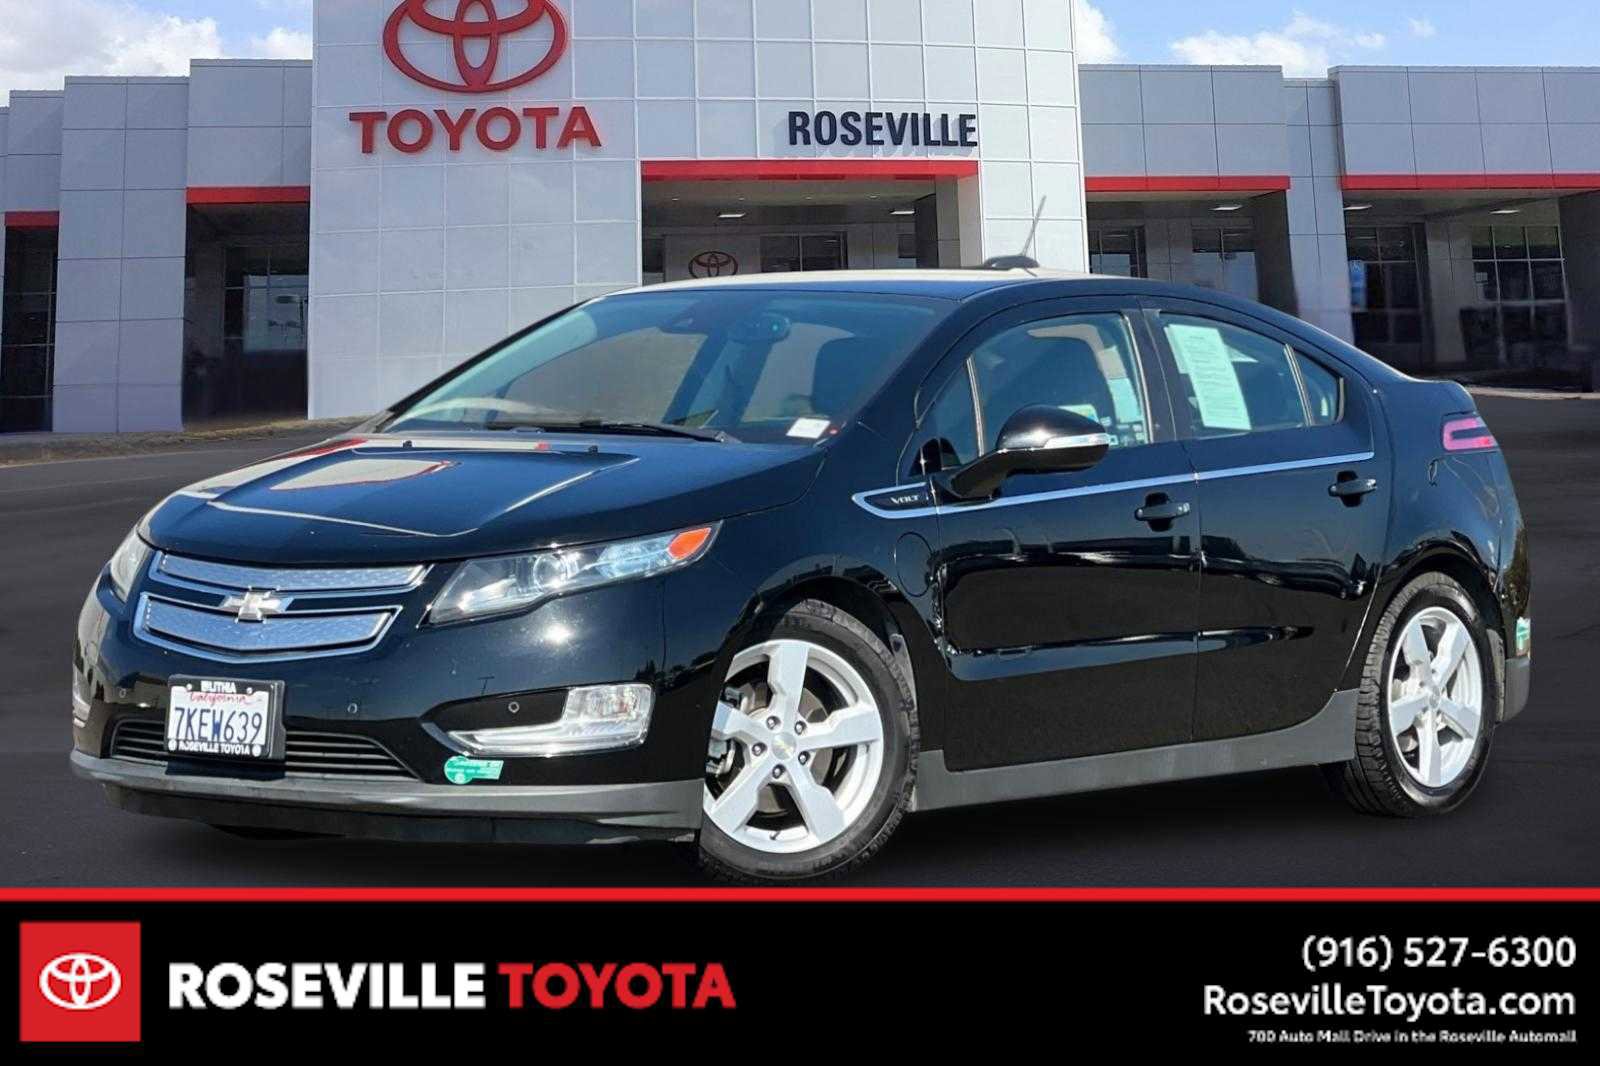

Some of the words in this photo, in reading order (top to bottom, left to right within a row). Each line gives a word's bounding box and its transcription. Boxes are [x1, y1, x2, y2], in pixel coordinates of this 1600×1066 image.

[349, 106, 602, 154] TOYOTA
[788, 110, 978, 147] ROSEVILLE
[174, 706, 263, 743] 7KEW639
[220, 744, 250, 755] TOYOTA
